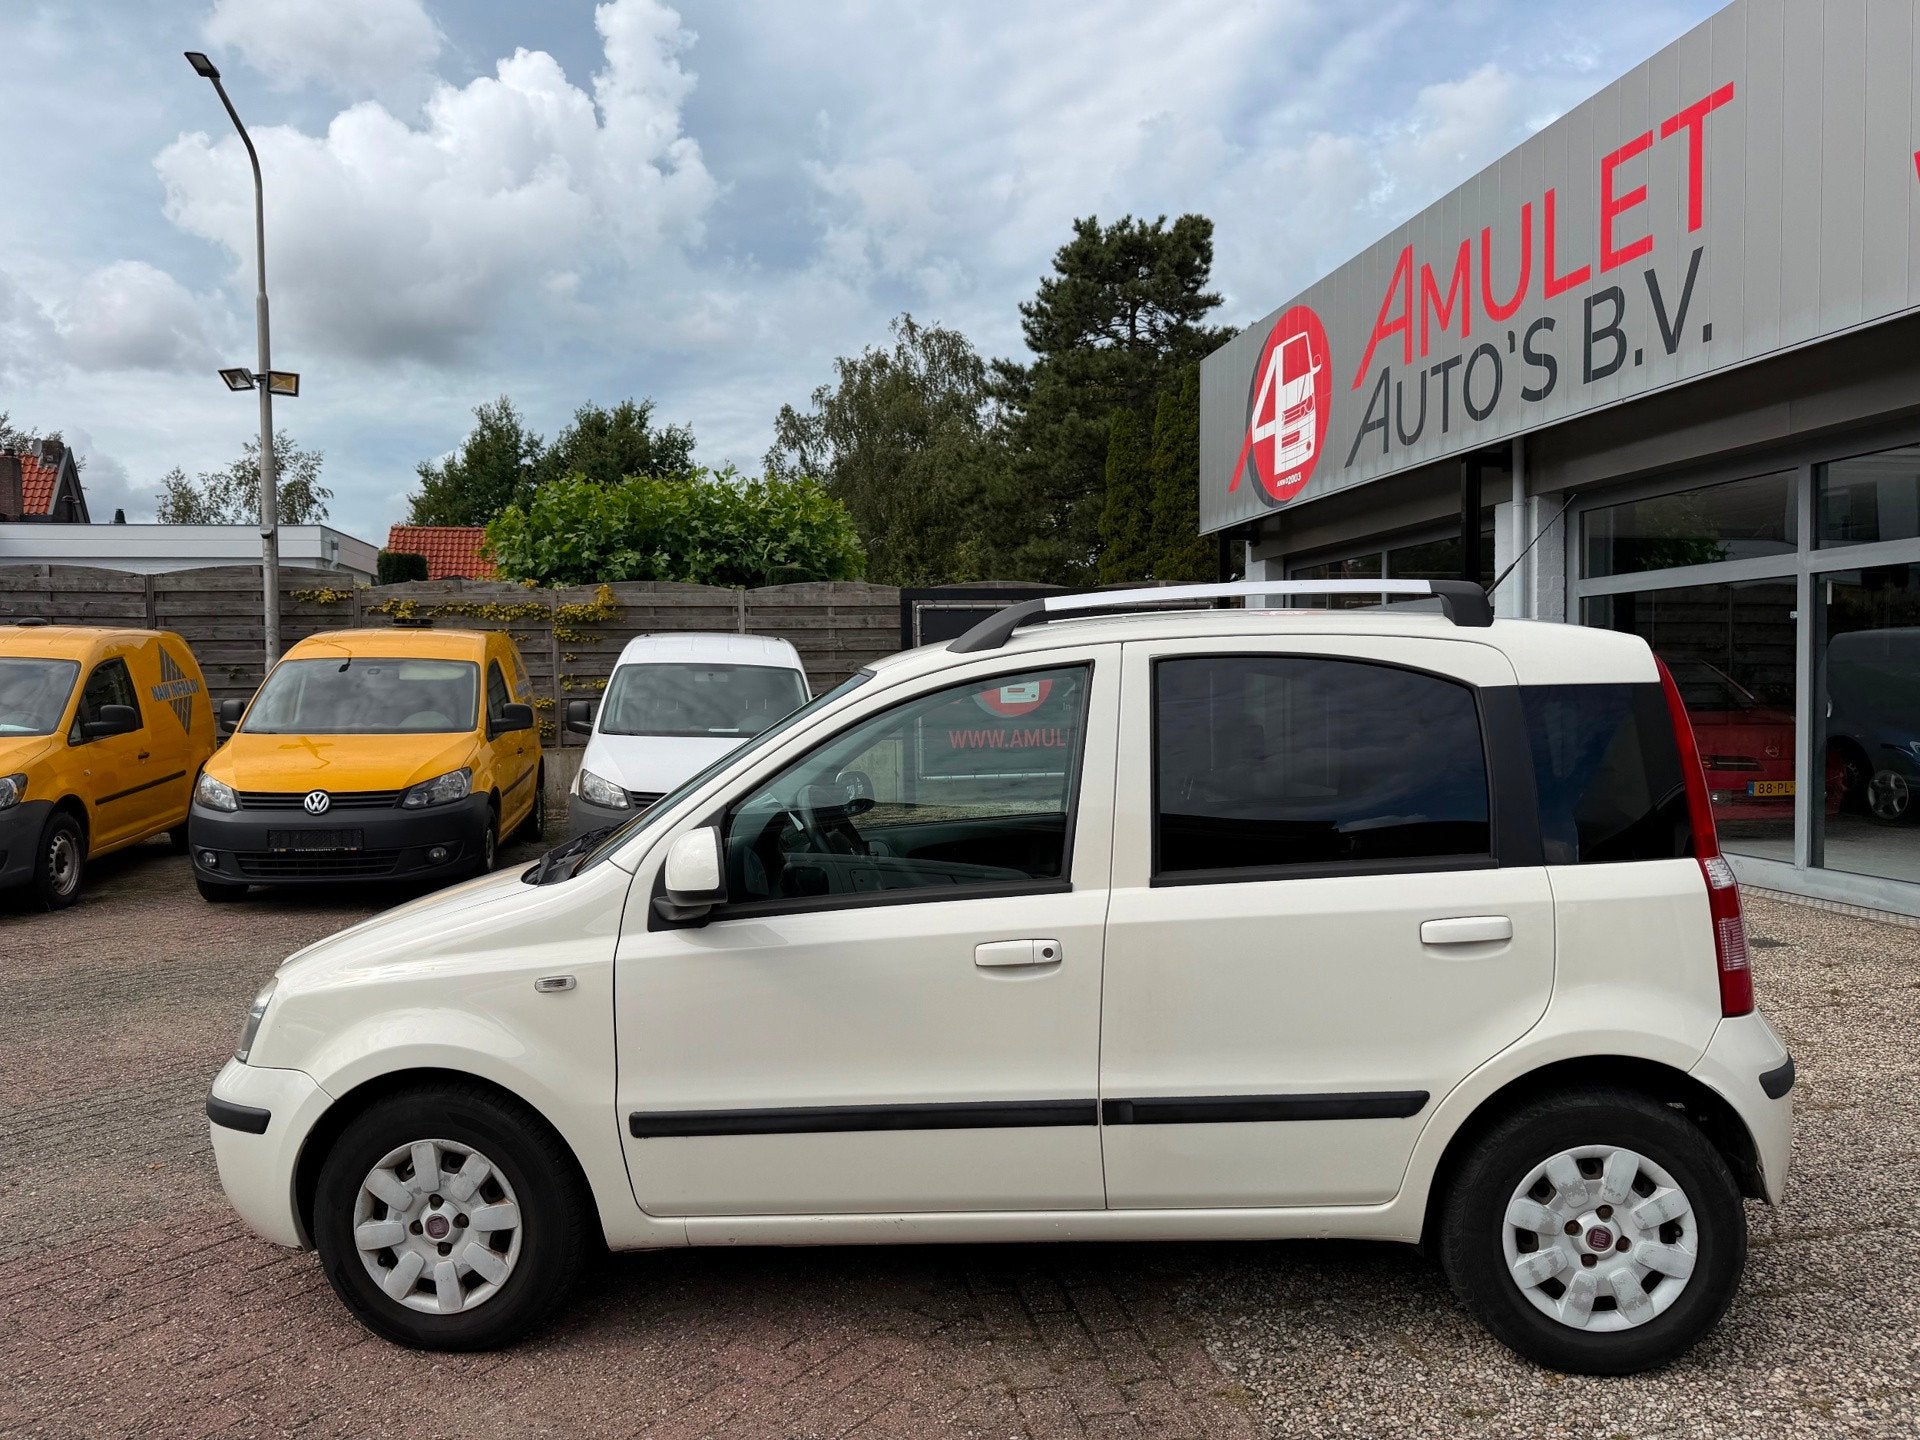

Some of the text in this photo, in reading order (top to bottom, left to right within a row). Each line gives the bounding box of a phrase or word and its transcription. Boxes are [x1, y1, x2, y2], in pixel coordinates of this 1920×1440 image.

[1351, 81, 1734, 391] AMULET
[1345, 246, 1713, 468] AUTO'S B.V.
[949, 728, 1069, 749] WWW.AMUL
[1758, 782, 1795, 794] 88-PL-
